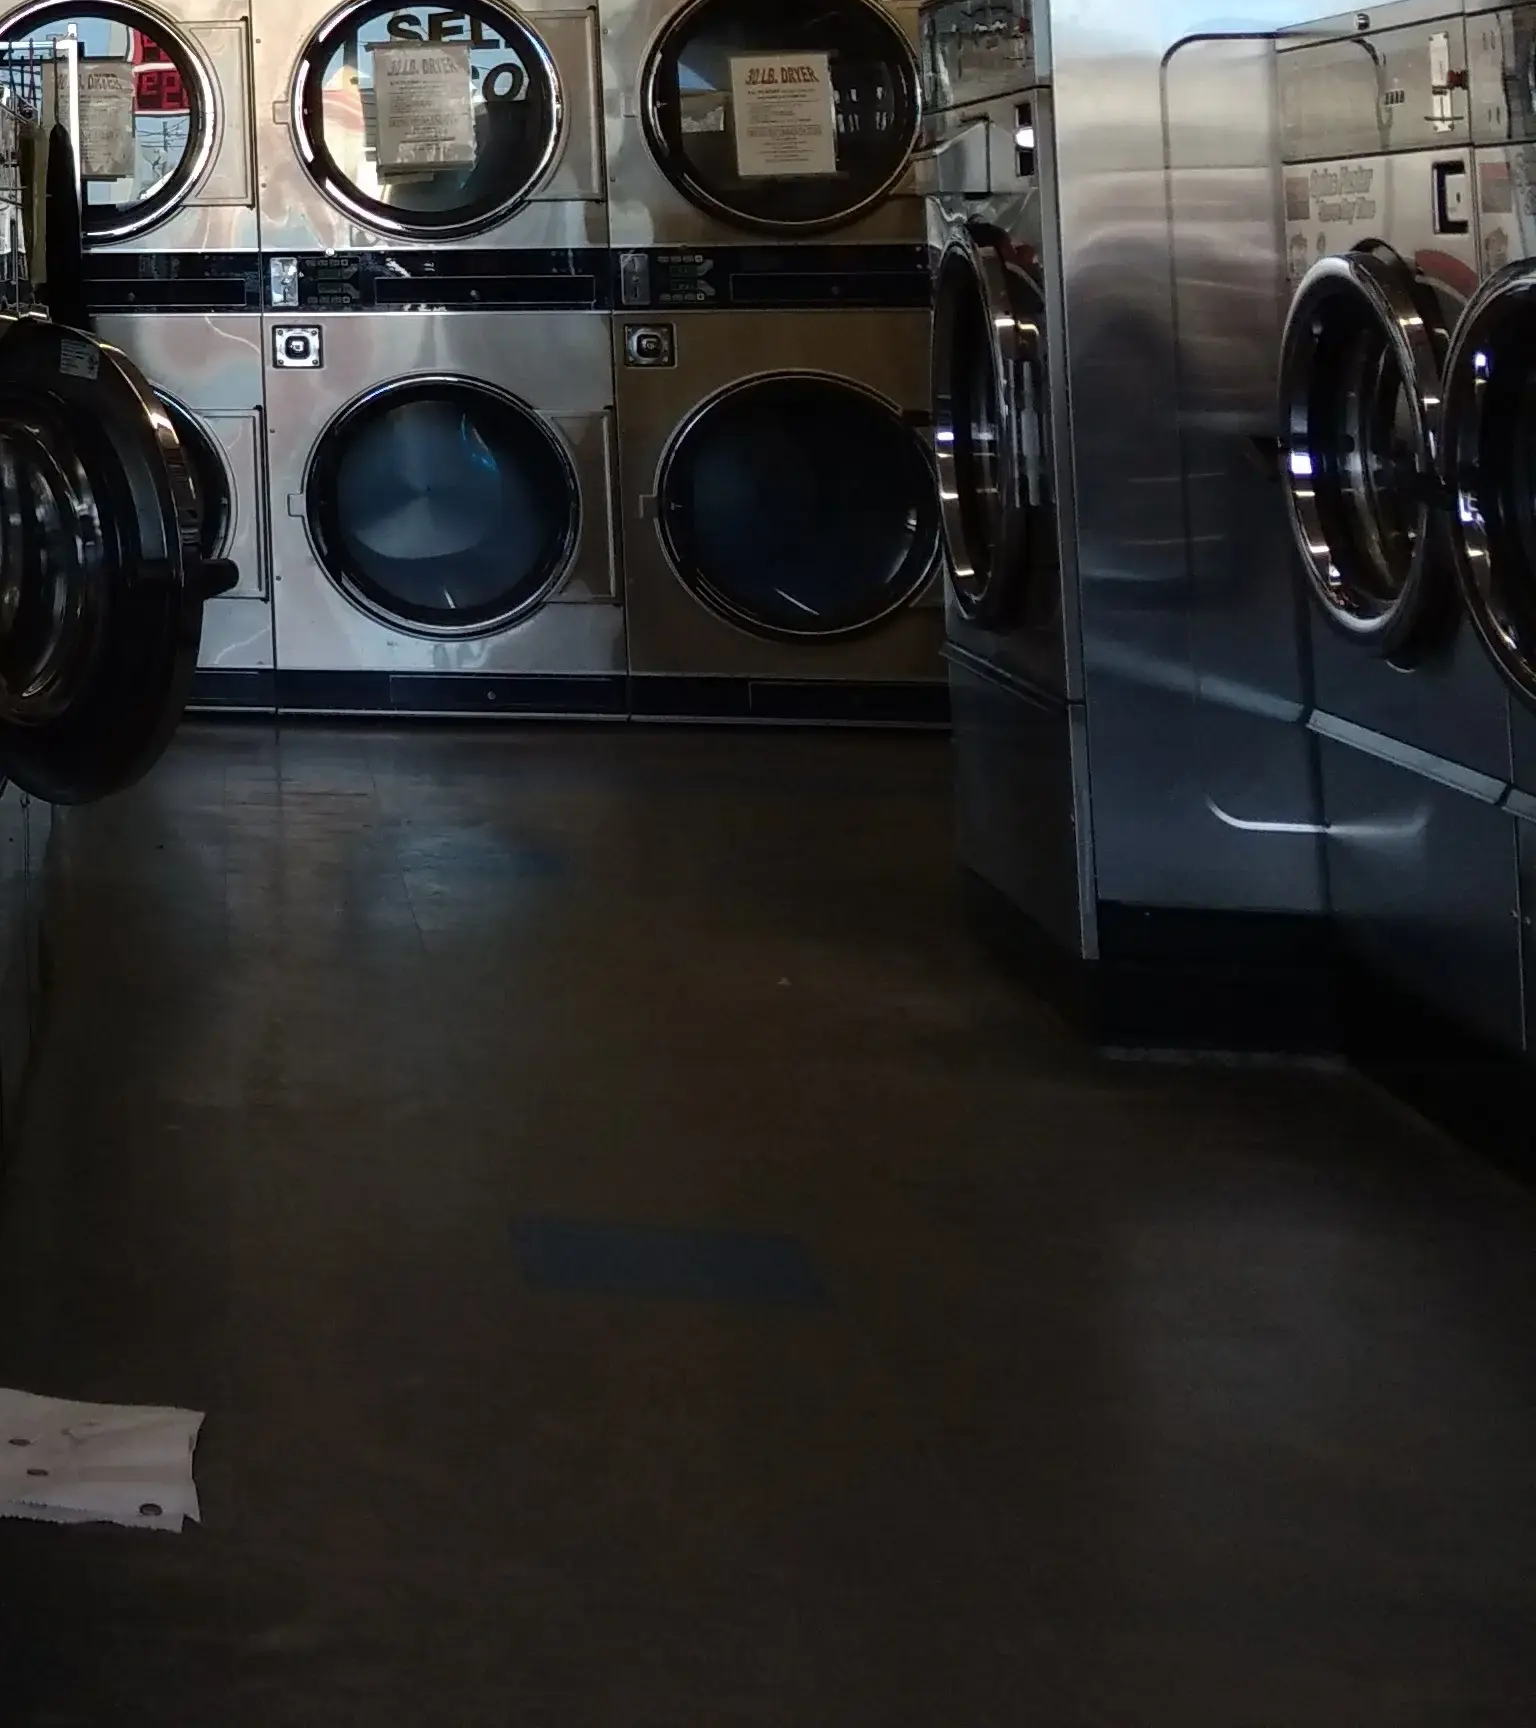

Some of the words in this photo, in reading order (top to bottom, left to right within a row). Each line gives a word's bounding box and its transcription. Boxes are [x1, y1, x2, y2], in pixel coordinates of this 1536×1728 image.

[387, 10, 504, 51] SEL
[422, 56, 459, 75] DRYER
[780, 66, 820, 84] DRYER
